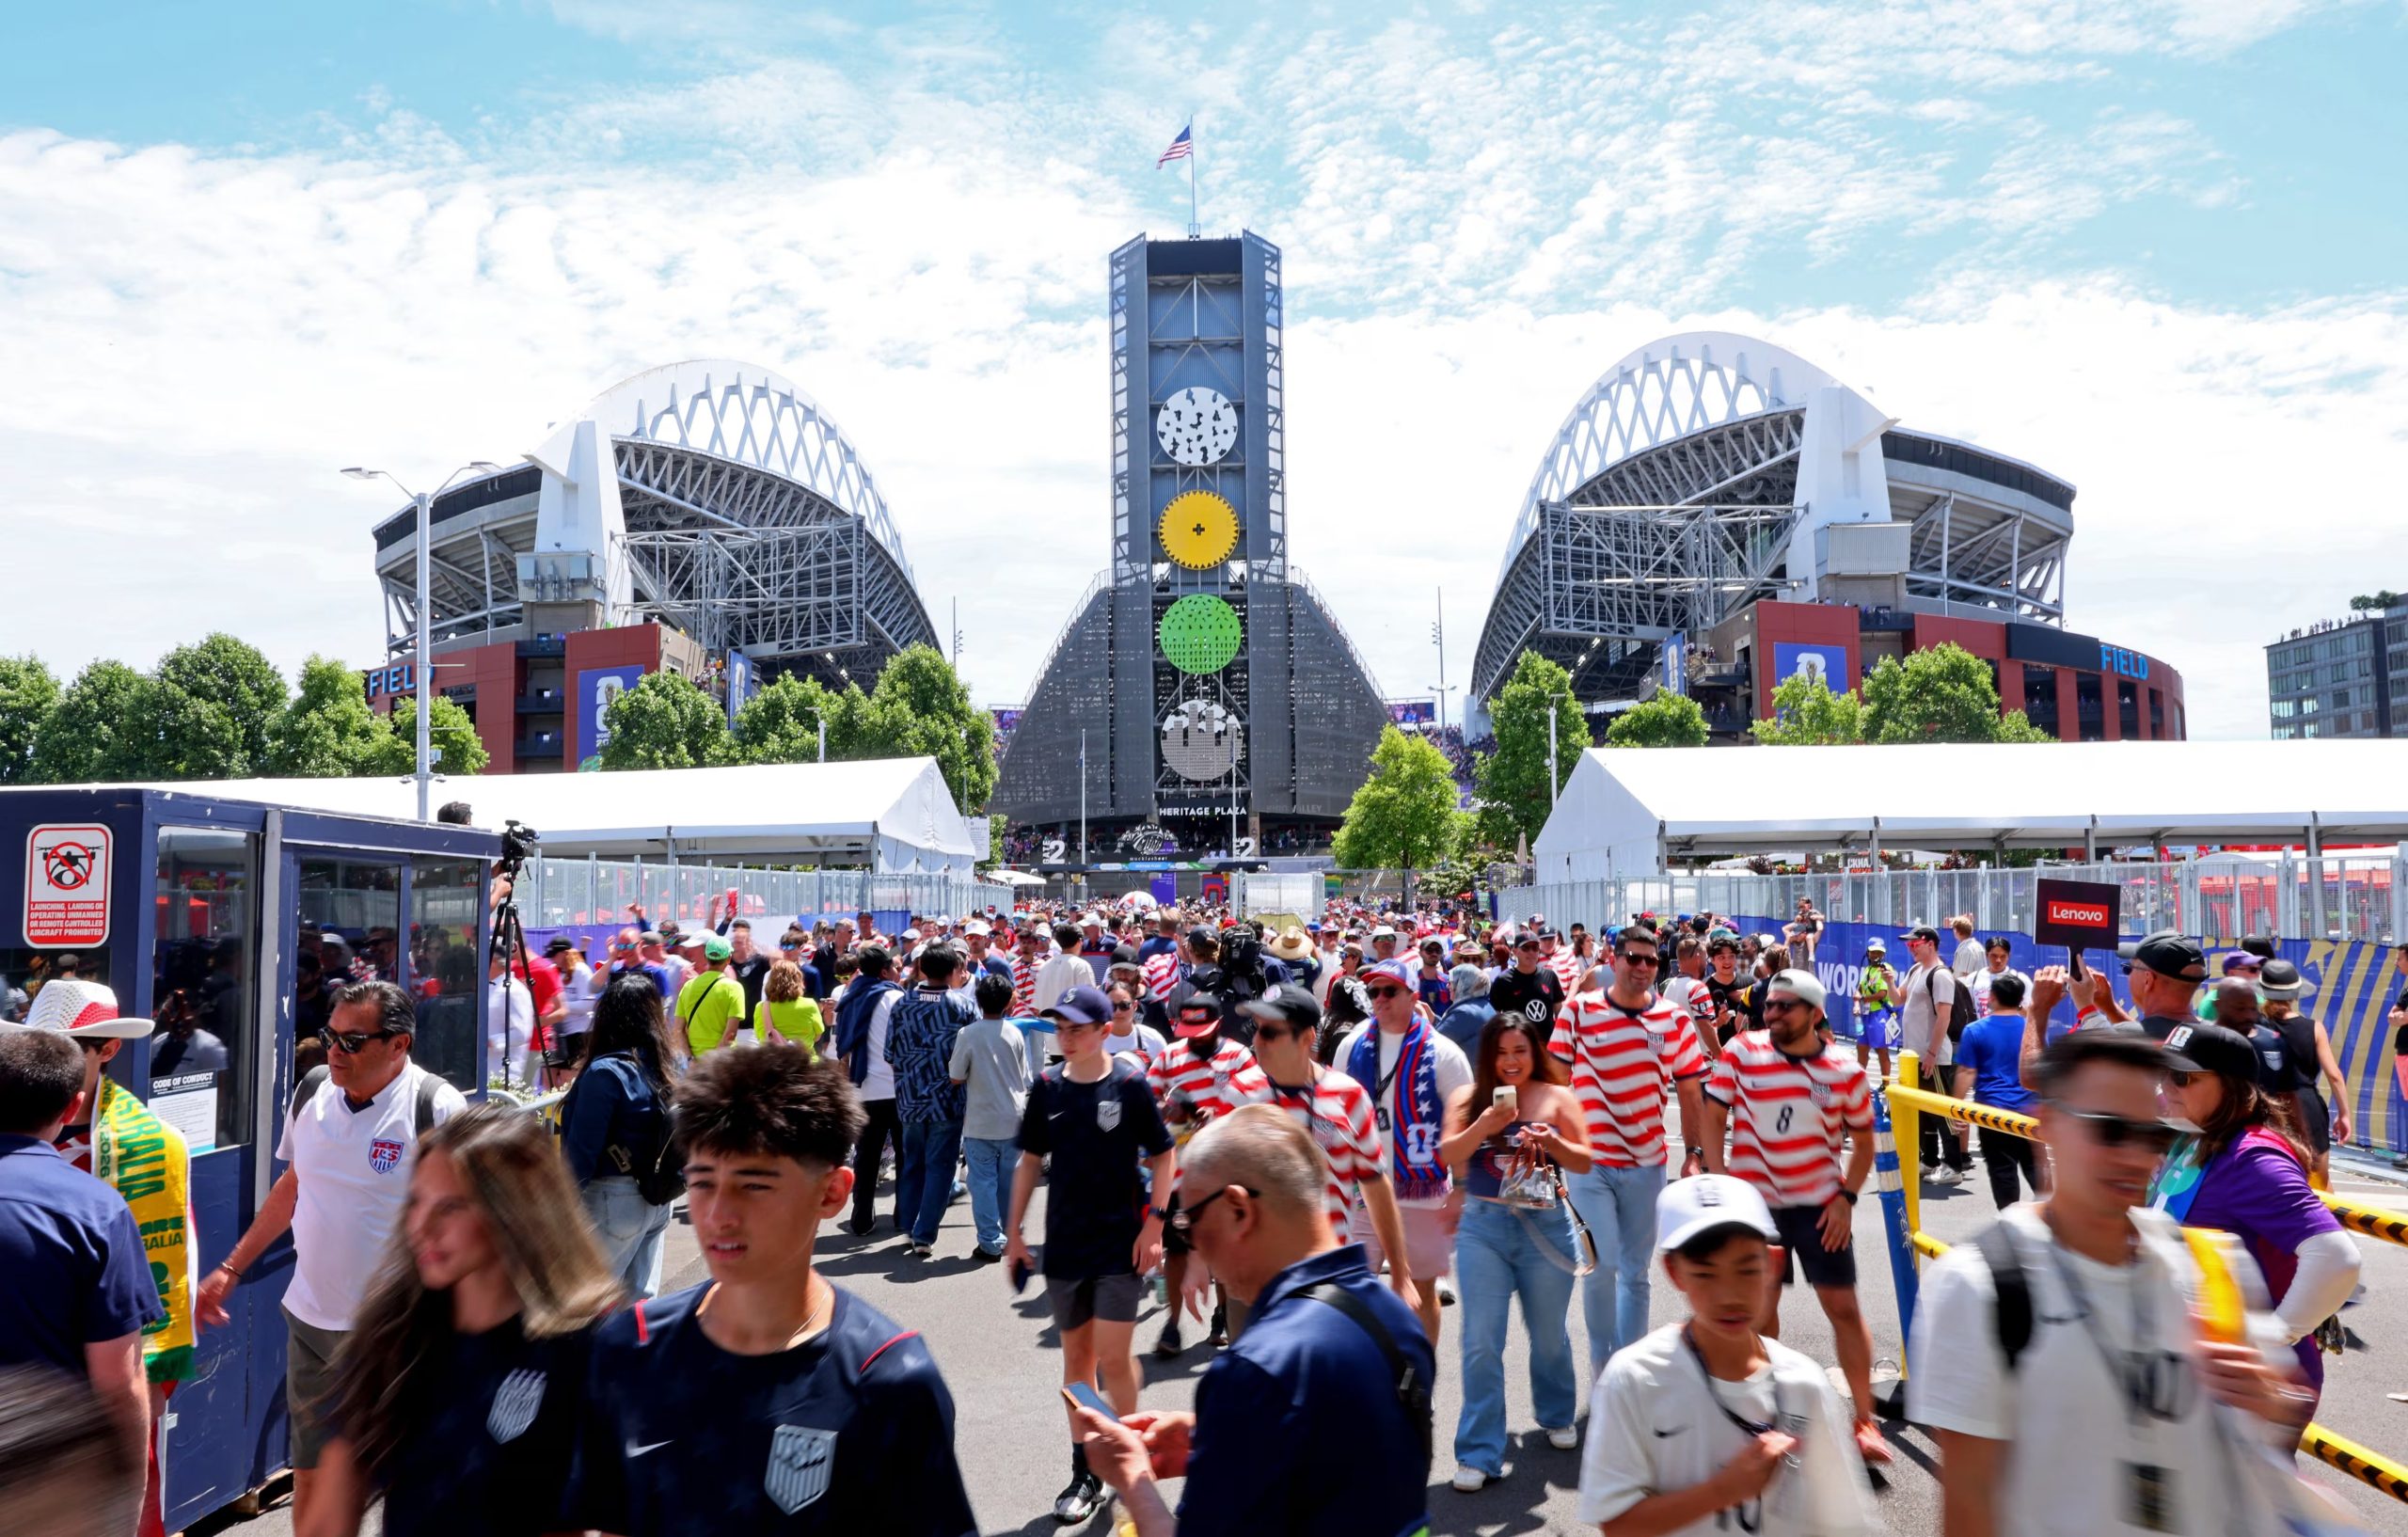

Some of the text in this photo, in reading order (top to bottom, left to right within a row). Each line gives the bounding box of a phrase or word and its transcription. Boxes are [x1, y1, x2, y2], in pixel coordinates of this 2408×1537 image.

[2100, 644, 2148, 680] FIELD
[1159, 806, 1247, 816] HERITAGE PLAZA
[1042, 839, 1051, 864] GATE
[1050, 840, 1066, 864] 2
[1240, 837, 1256, 862] 2
[2052, 906, 2103, 922] Lenovo
[1817, 961, 1865, 997] WOR
[919, 993, 942, 1003] STATES
[152, 1079, 172, 1089] CODE
[172, 1077, 182, 1086] OF
[182, 1072, 214, 1085] CONDUCT
[1775, 1103, 1794, 1135] 8
[99, 1132, 111, 1179] 2026
